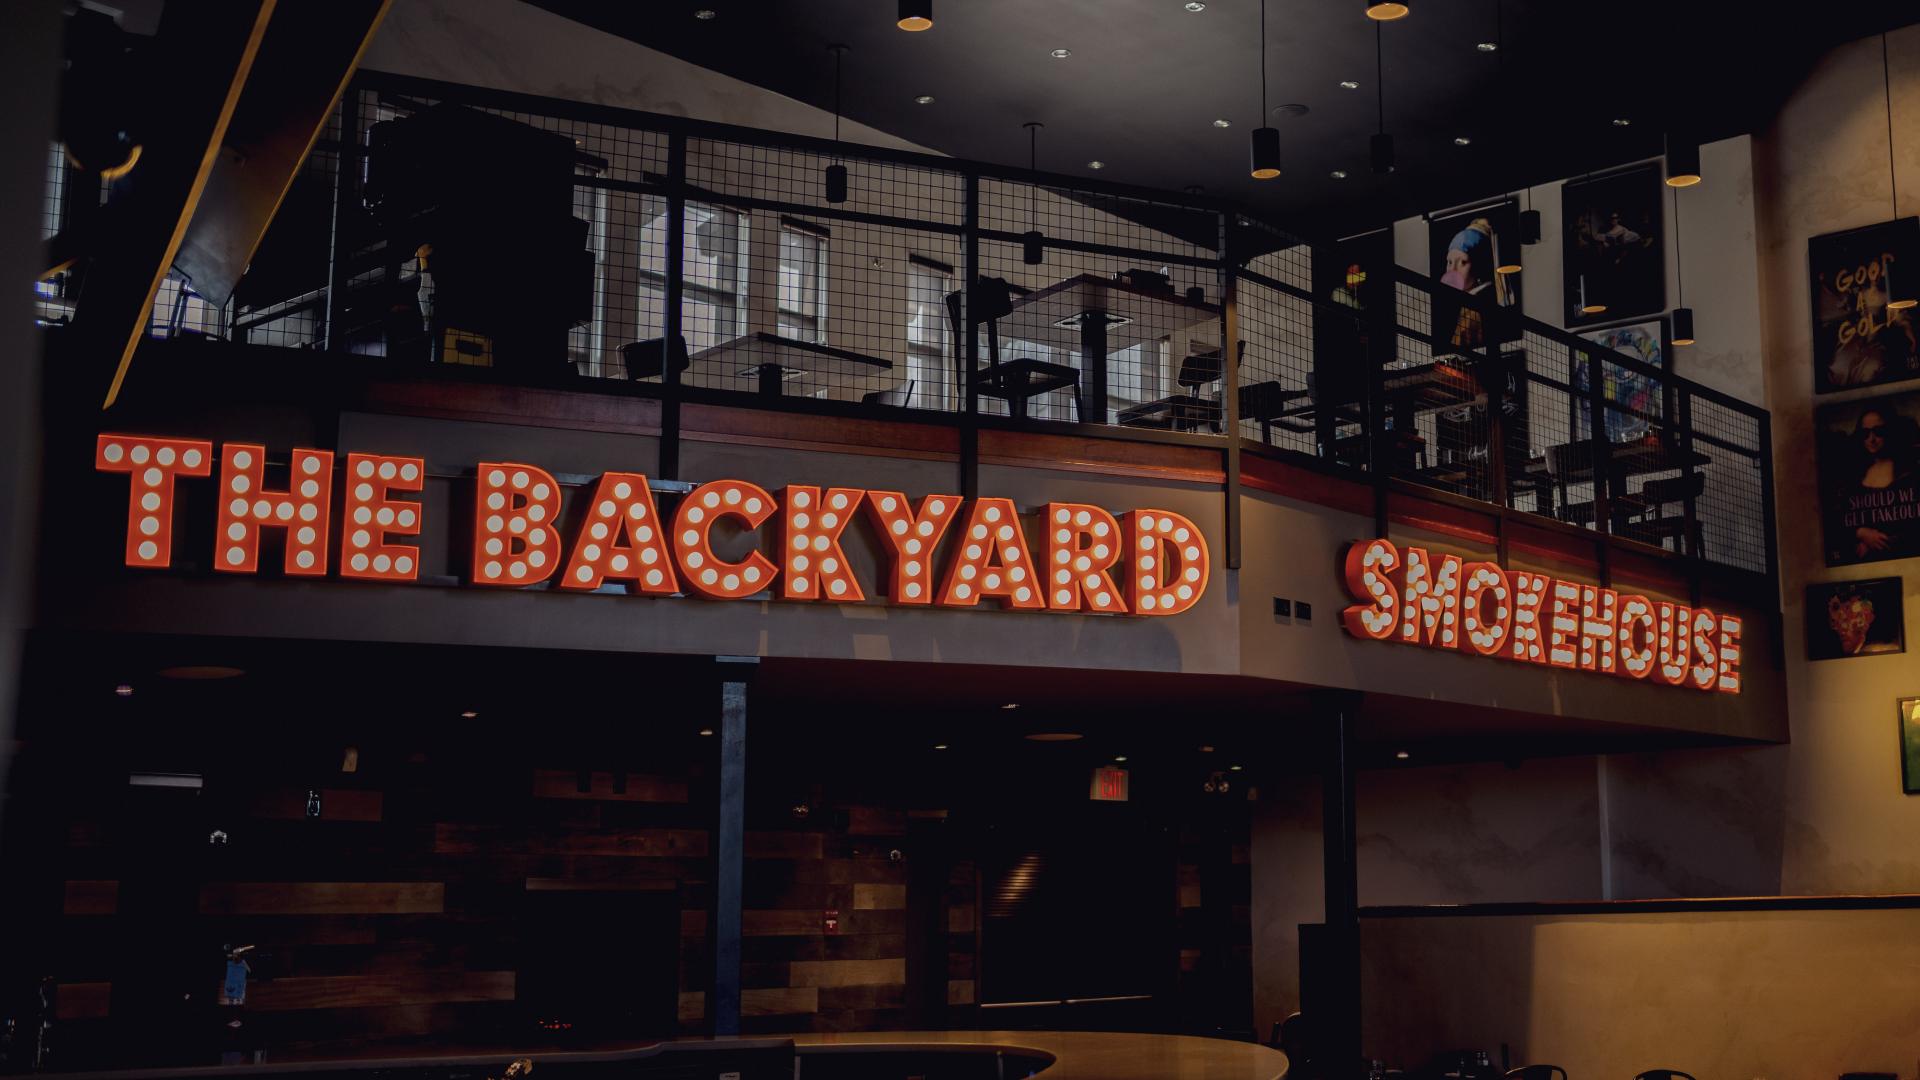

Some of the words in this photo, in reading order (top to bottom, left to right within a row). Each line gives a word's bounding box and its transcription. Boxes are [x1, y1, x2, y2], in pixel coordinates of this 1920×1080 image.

[1849, 490, 1894, 510] SHOULD
[1899, 487, 1914, 502] WE
[96, 434, 425, 578] THE
[472, 462, 1210, 615] BACKYARD
[1844, 510, 1865, 527] GET
[1343, 538, 1742, 693] SMOKEHOUSE
[1101, 770, 1125, 798] EXIT
